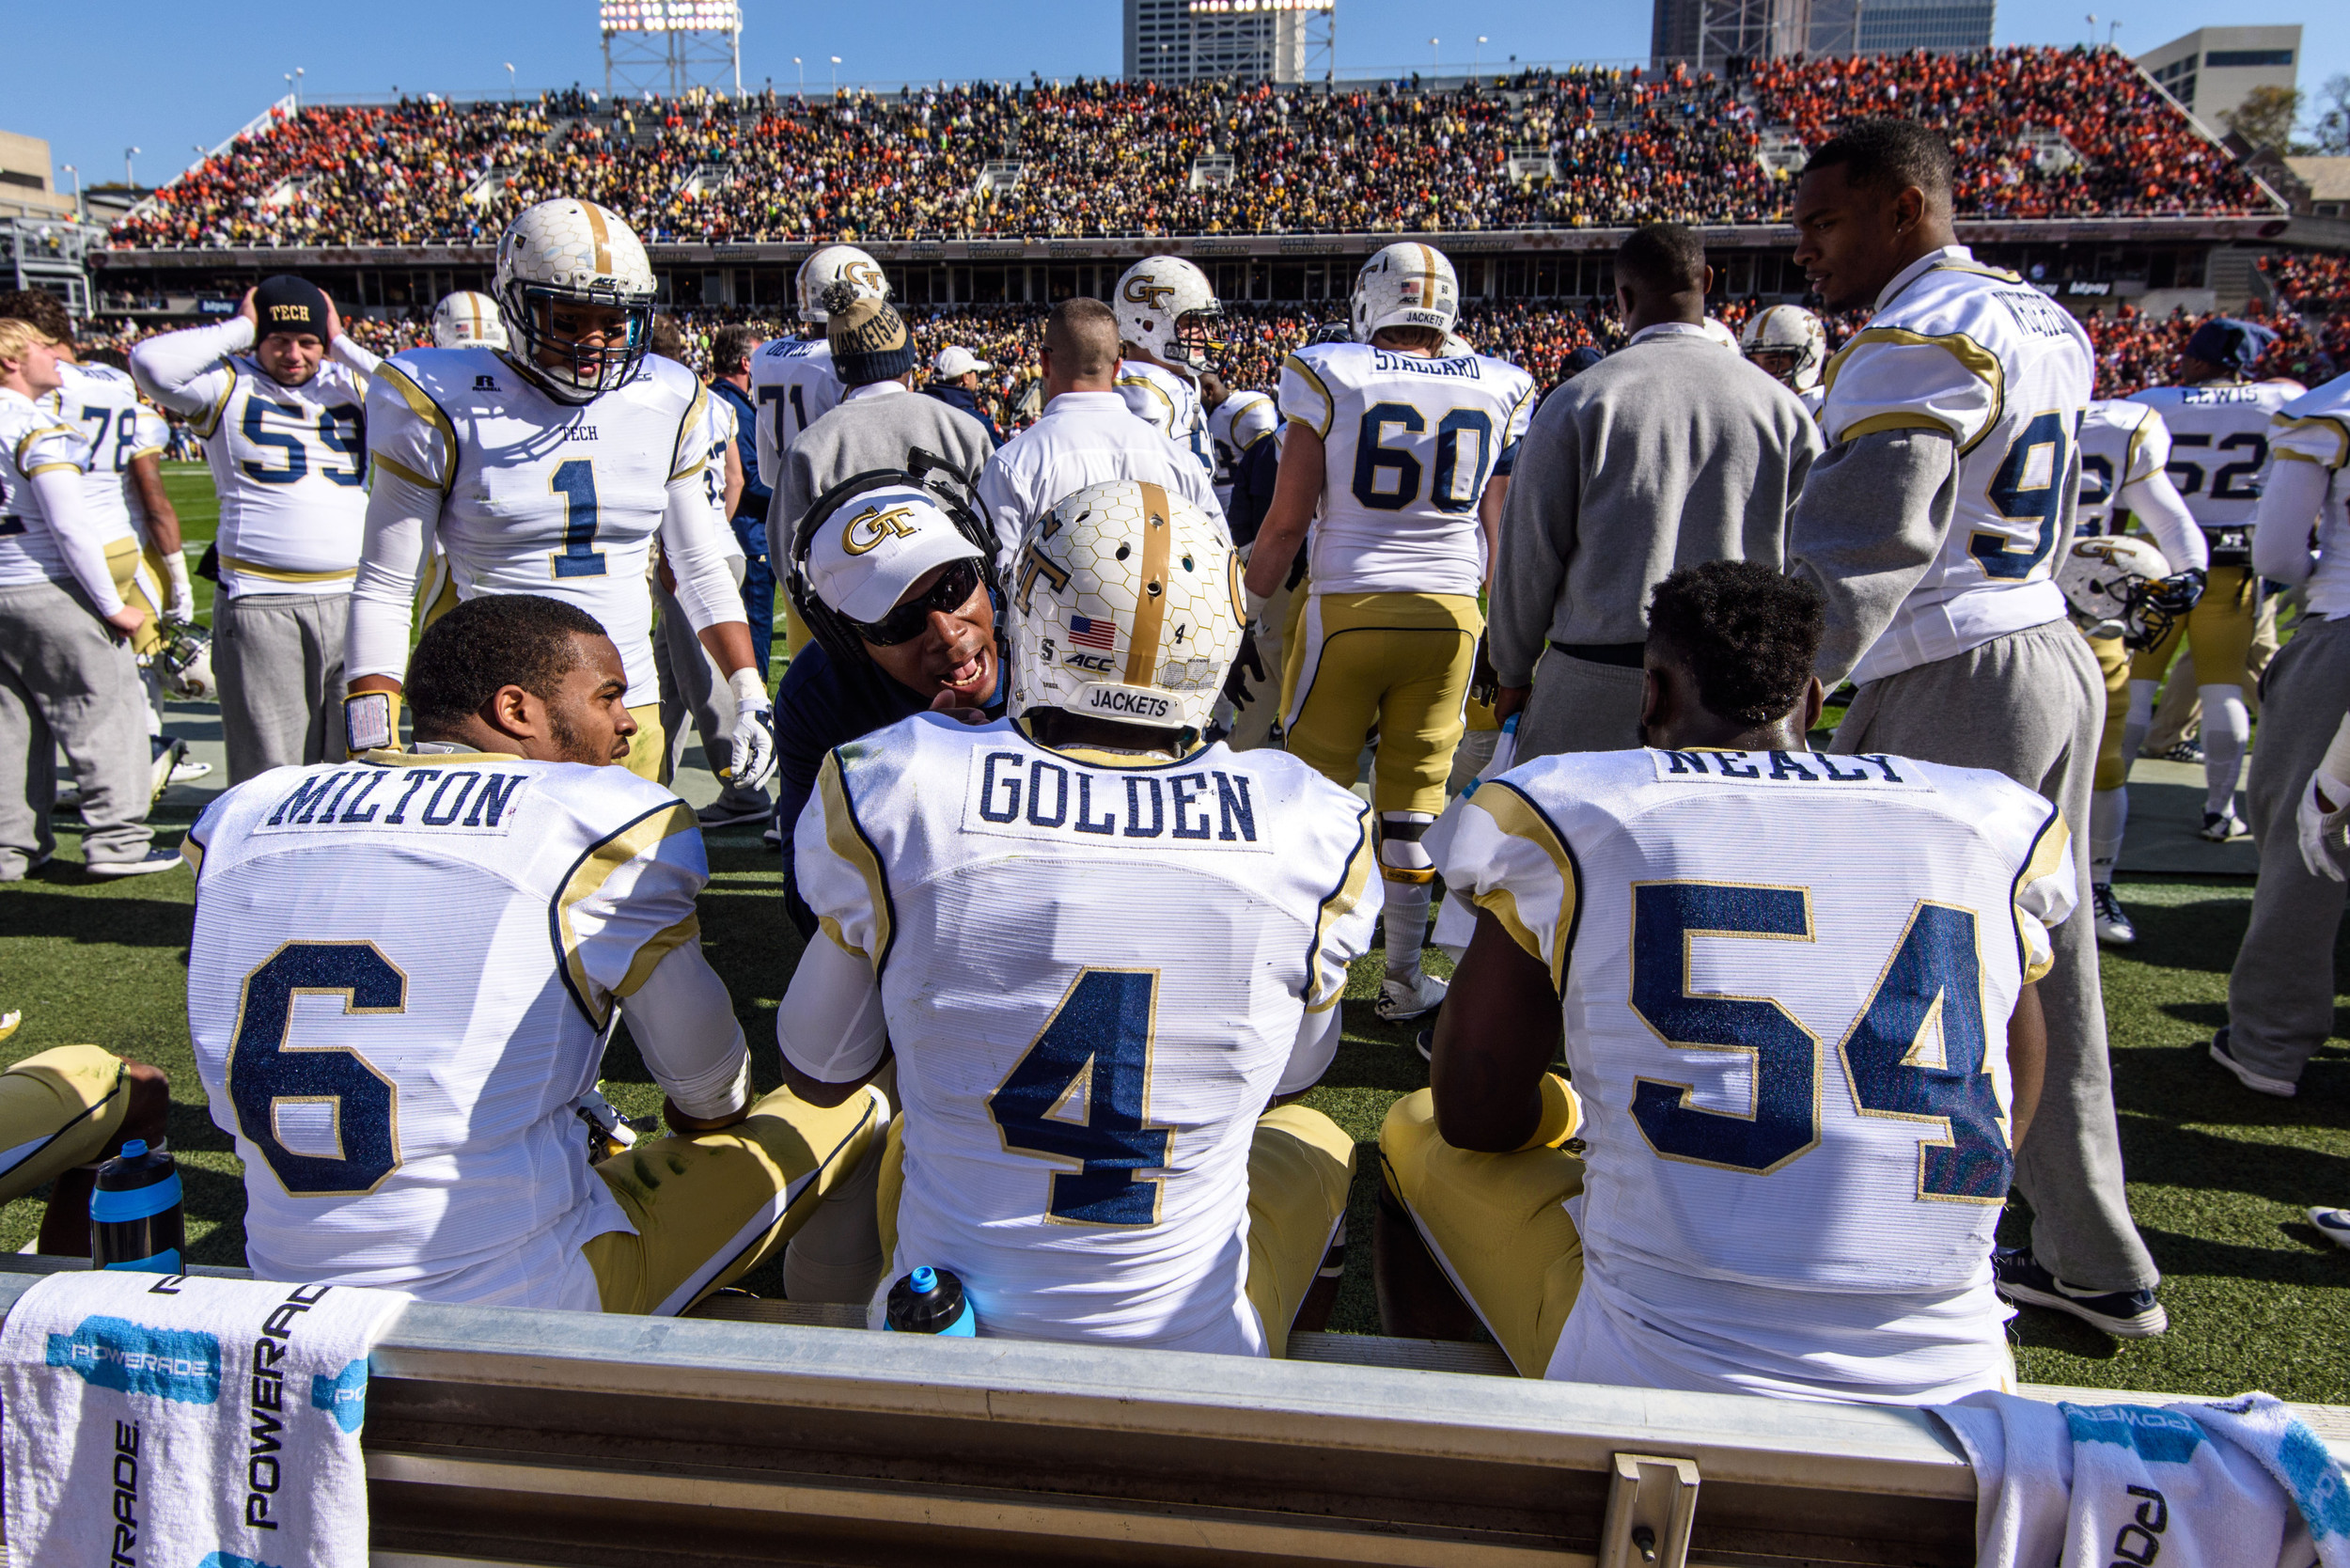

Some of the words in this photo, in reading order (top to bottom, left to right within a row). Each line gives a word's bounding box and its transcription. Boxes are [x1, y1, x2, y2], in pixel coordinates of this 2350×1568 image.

[714, 252, 759, 260] MORRIS
[1193, 245, 1249, 254] HEISMAN
[845, 261, 882, 291] GT
[1123, 274, 1175, 309] GT
[2068, 281, 2110, 296] bitpay
[269, 305, 310, 322] TECH
[1406, 312, 1445, 326] JACKETS
[837, 314, 892, 354] JACKETS
[1373, 348, 1480, 380] STALLARD
[2182, 387, 2258, 404] LEWIS
[80, 404, 137, 474] 78
[559, 425, 599, 442] TECH
[758, 384, 807, 459] 71
[239, 393, 367, 488] 59
[1351, 400, 1494, 514] 60
[2165, 432, 2269, 499] 52
[548, 456, 609, 580] 1
[842, 505, 917, 556] GT
[2073, 539, 2137, 567] GT
[1175, 622, 1185, 645] 4
[1065, 653, 1115, 672] ACC
[1091, 689, 1169, 717] JACKETS
[1665, 750, 1904, 783] NEALY
[267, 770, 527, 828] MILTON
[980, 752, 1258, 842] GOLDEN
[1627, 880, 2015, 1205] 54
[226, 939, 408, 1198] 6
[985, 964, 1178, 1227] 4
[245, 1284, 333, 1529] POWERAD
